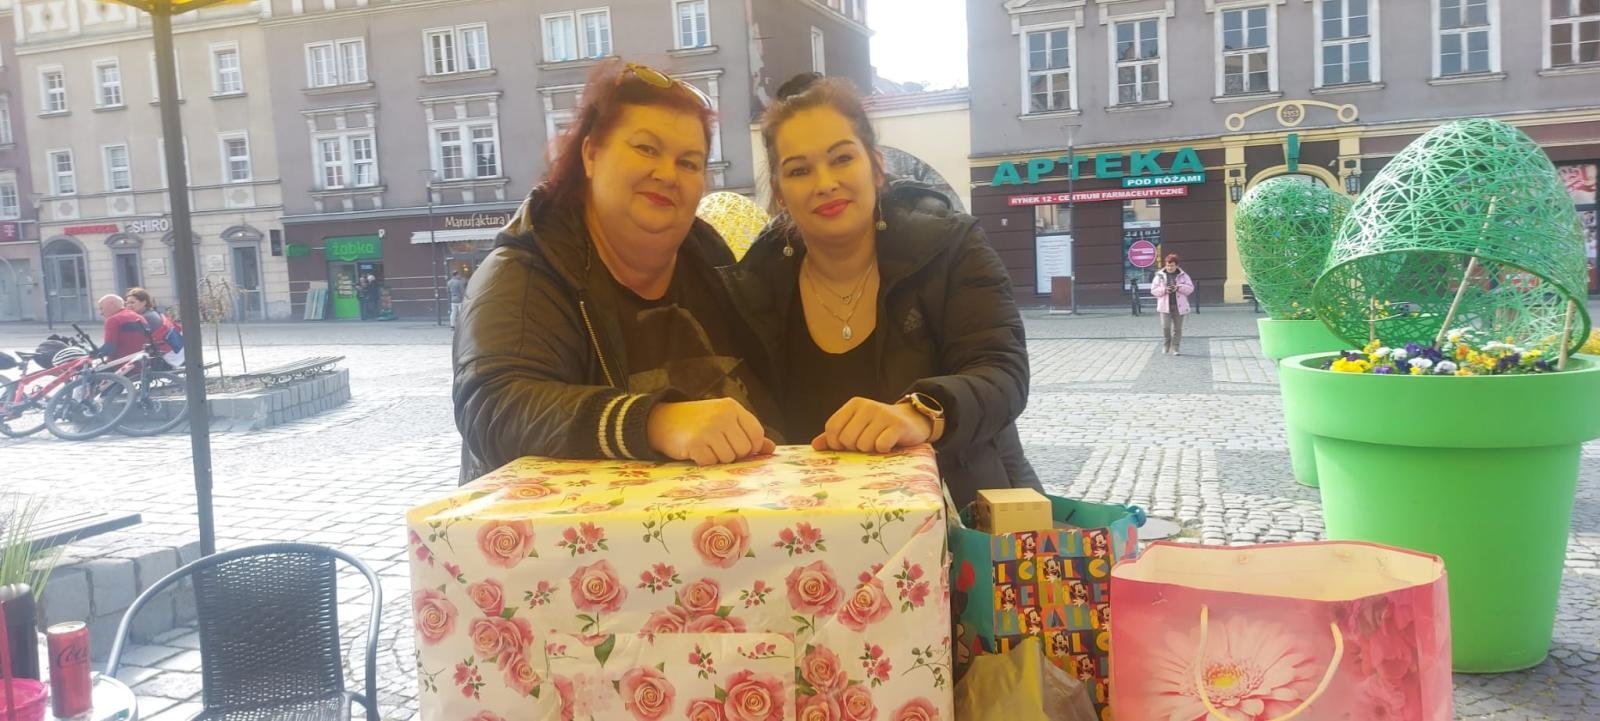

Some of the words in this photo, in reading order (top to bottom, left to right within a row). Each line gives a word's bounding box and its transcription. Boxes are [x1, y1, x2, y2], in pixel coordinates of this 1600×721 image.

[989, 147, 1205, 187] APTEKA
[1127, 178, 1151, 186] POD
[1155, 174, 1201, 184] RÓŻAMI
[1011, 196, 1040, 204] RYNEK
[1043, 195, 1052, 203] 12
[1102, 187, 1184, 199] FARMACEUTYCZNE
[132, 219, 169, 233] SHIRO
[444, 212, 505, 228] Manufaktura
